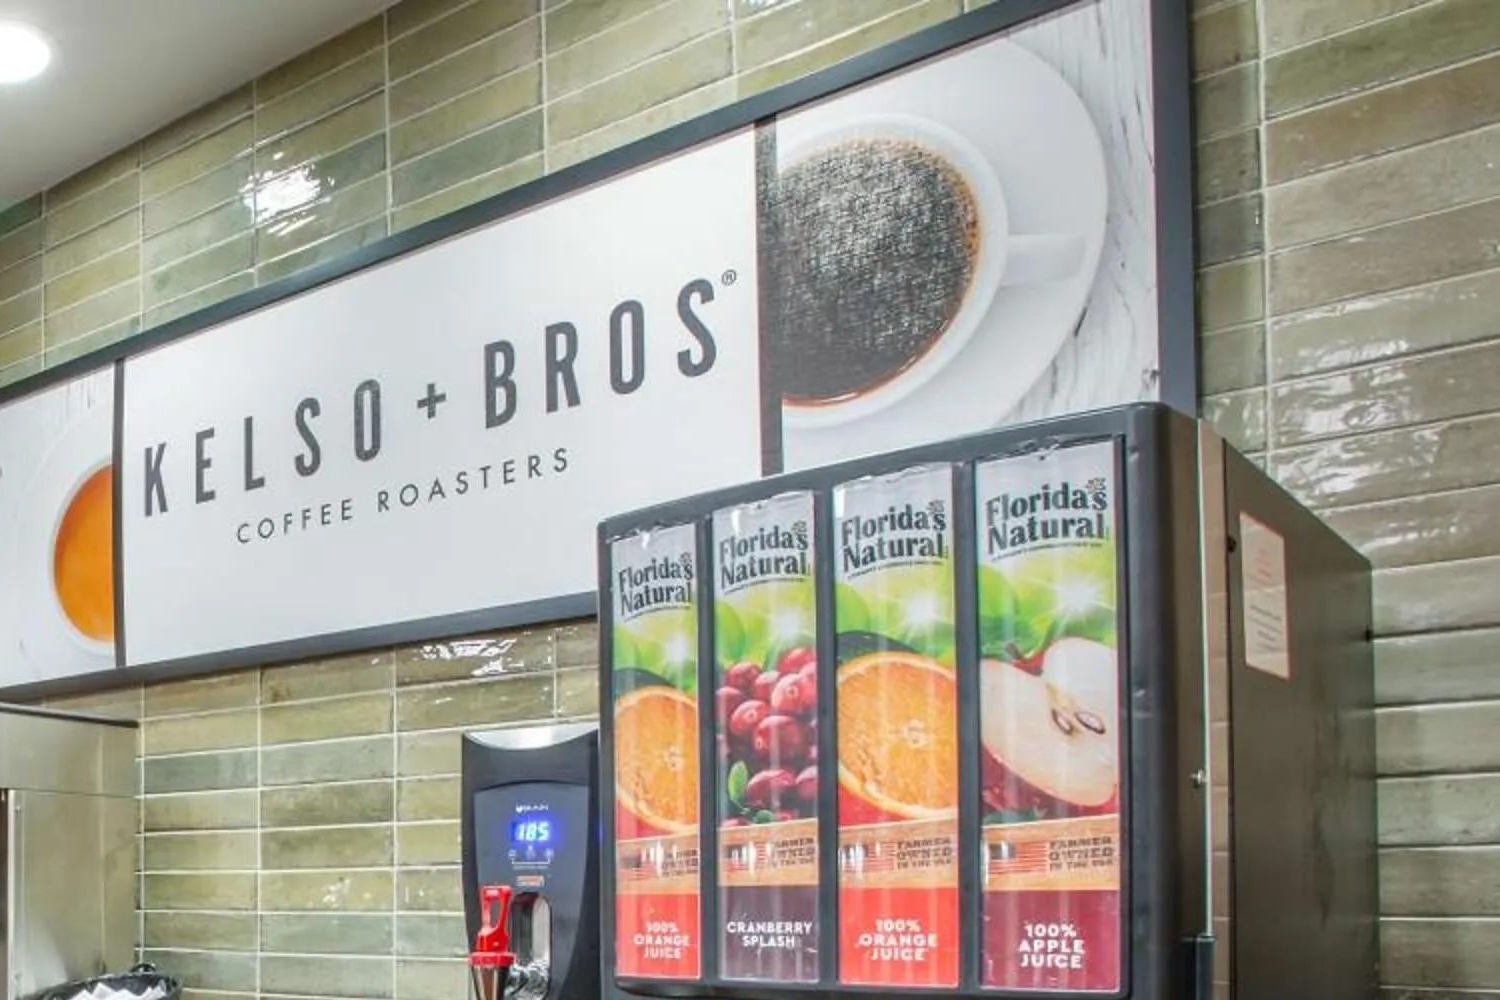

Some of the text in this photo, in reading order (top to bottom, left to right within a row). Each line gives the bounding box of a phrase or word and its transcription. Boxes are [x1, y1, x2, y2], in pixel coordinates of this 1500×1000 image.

[143, 378, 382, 518] KELSO
[236, 447, 570, 545] COFFEE ROASTERS
[987, 478, 1108, 526] Florida's
[841, 500, 947, 544] Florida's
[718, 524, 809, 563] Florida's
[988, 513, 1102, 555] Natural
[842, 533, 944, 573] Natural
[618, 553, 694, 593] Florida's
[720, 554, 808, 590] Natural
[620, 582, 693, 617] Natural
[515, 821, 549, 841] 185
[727, 921, 813, 934] CRANBERRY
[876, 919, 921, 932] 100%
[1024, 924, 1077, 938] 100%
[633, 933, 690, 946] ORANGE
[742, 935, 796, 948] SPLASH
[859, 933, 938, 947] ORANGE
[1018, 939, 1086, 953] APPLE
[643, 947, 682, 959] JUICE
[870, 948, 925, 961] JUICE
[1020, 954, 1082, 968] JUICE
